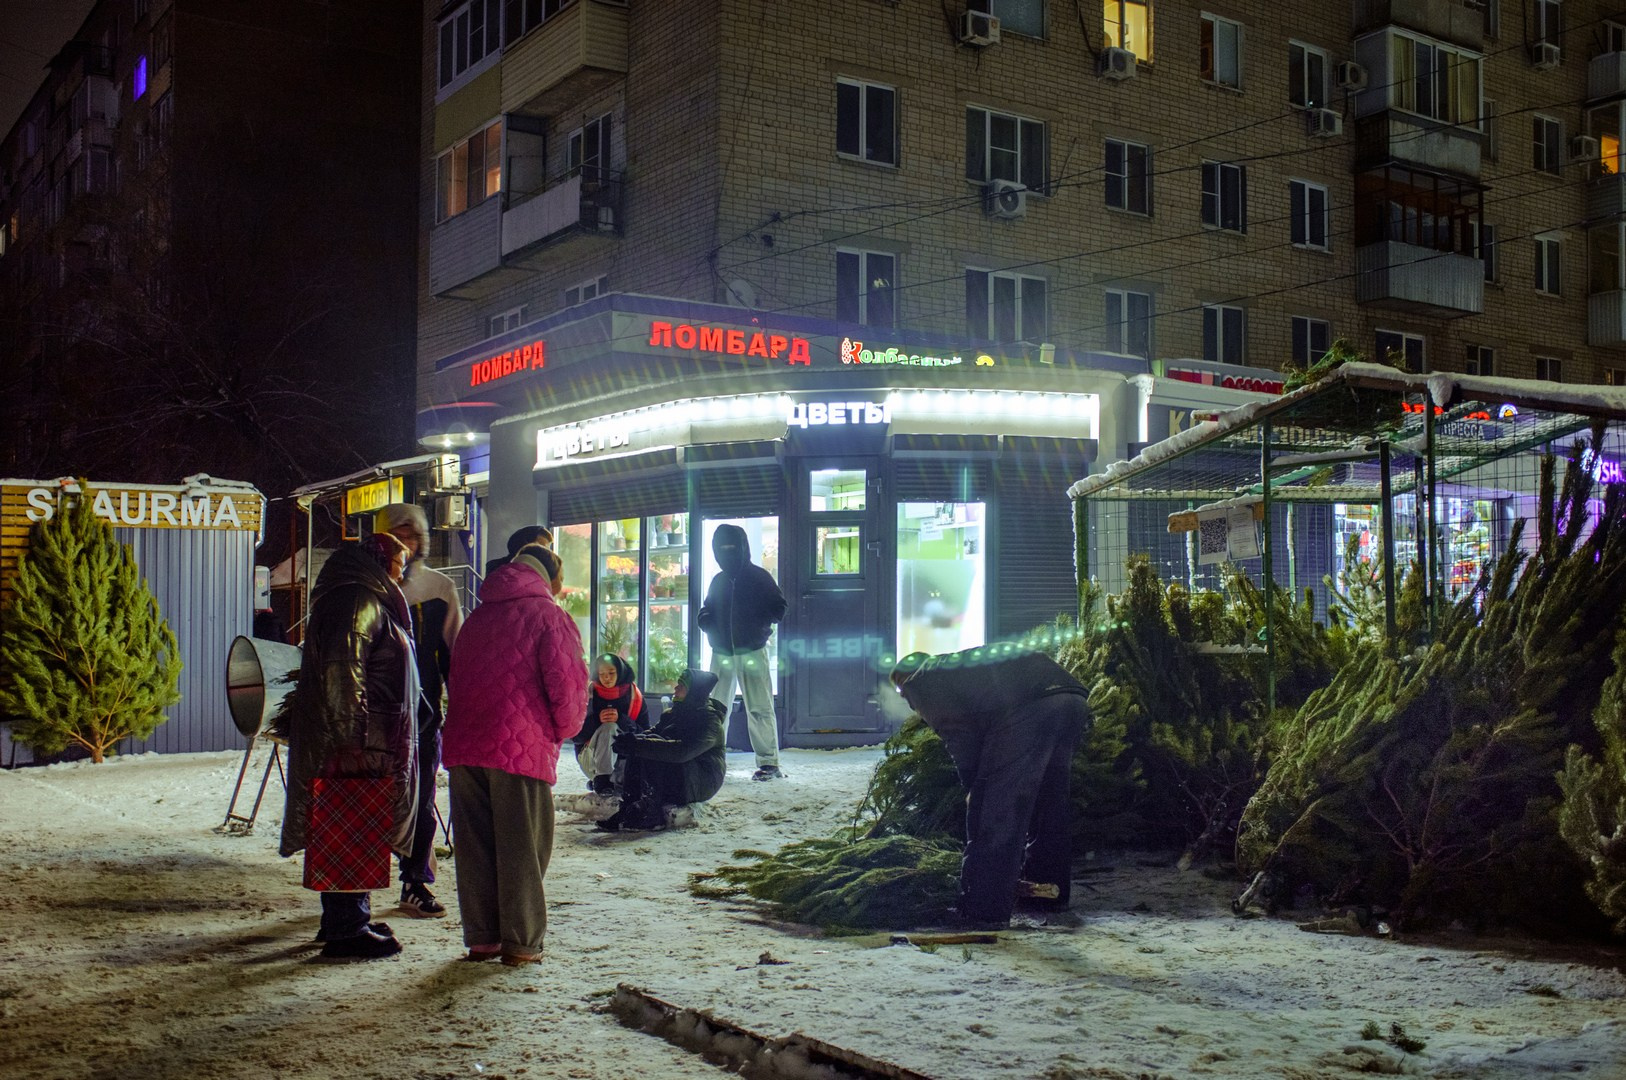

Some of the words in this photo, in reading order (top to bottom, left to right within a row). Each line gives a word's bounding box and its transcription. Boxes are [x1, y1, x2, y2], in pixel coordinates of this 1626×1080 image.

[470, 340, 546, 387] ЛОМБАРД
[648, 320, 812, 367] ЛОМБАРД
[787, 401, 892, 429] ЦВЕТЫ
[551, 425, 630, 461] ЦВЕТЫ
